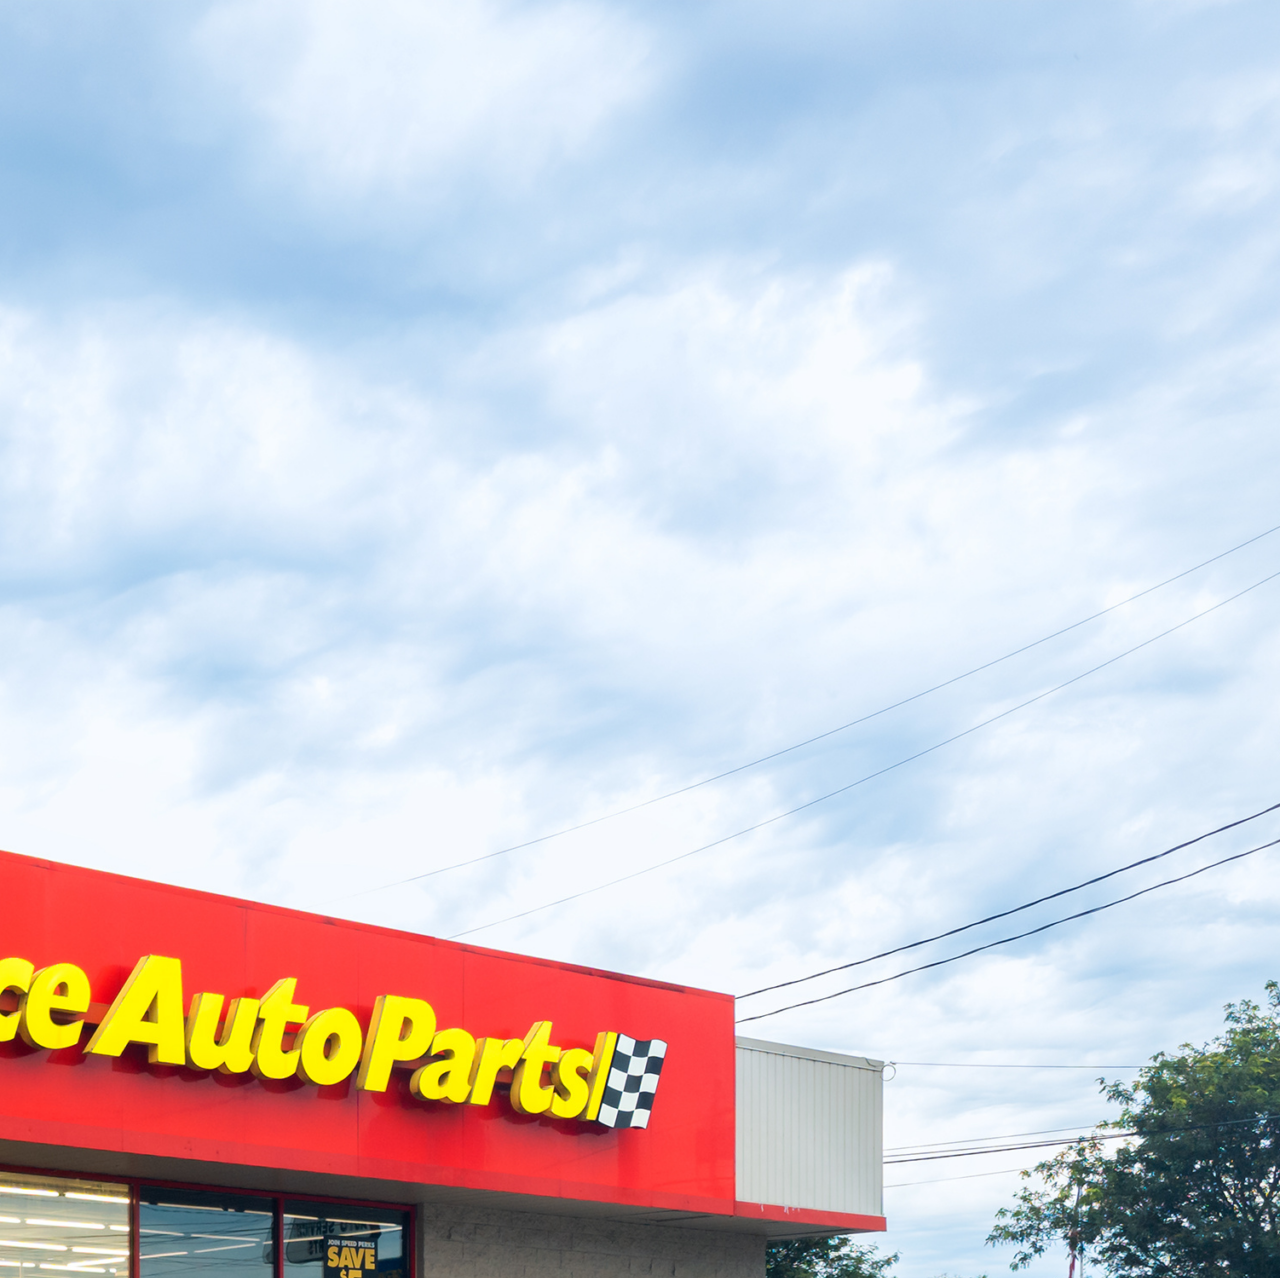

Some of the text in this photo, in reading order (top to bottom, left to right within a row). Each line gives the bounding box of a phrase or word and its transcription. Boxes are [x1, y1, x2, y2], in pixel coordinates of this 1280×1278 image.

[83, 953, 362, 1085] Auto
[356, 994, 598, 1120] Parts
[327, 1246, 375, 1270] SAVE
